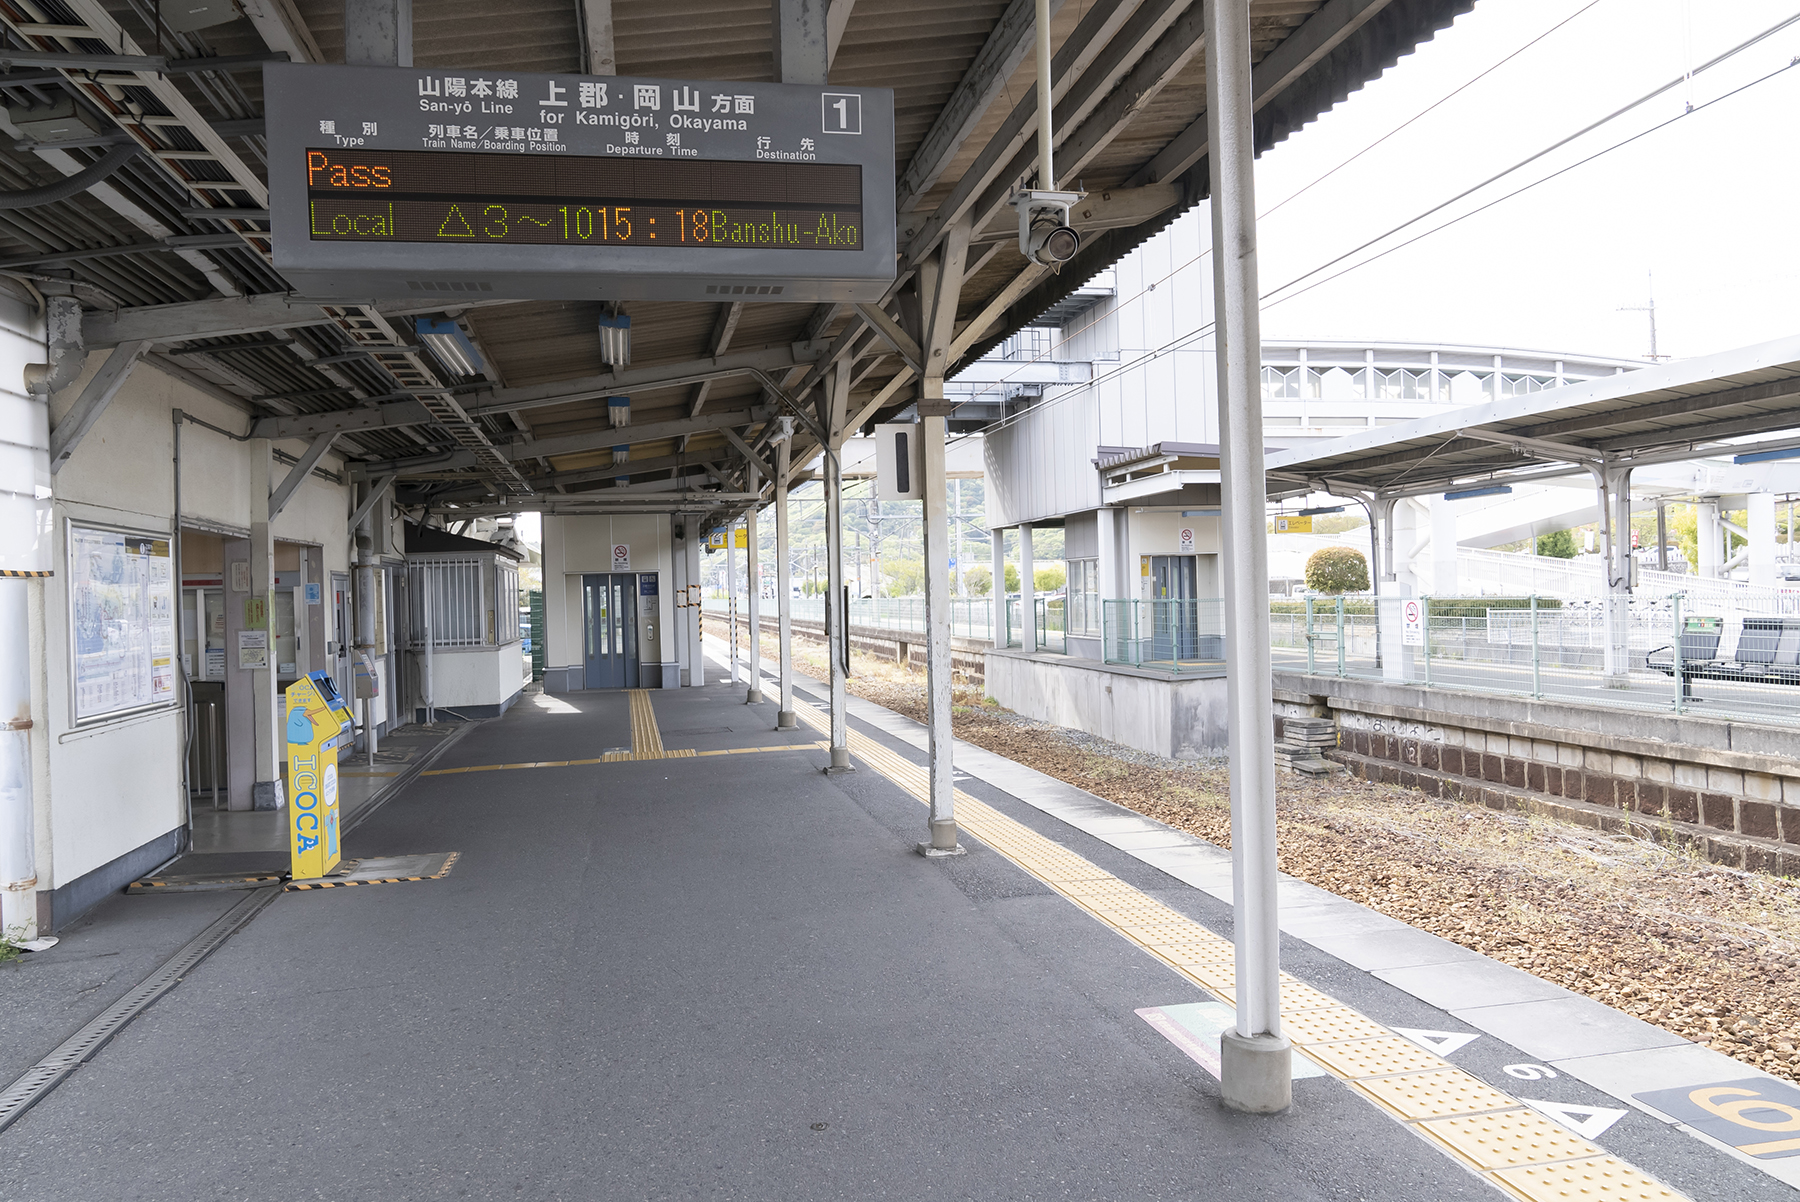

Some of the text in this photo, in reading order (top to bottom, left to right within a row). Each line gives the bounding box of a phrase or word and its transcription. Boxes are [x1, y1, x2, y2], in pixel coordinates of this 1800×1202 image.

[417, 76, 519, 99] 山陽本線
[711, 94, 755, 115] 方面
[419, 99, 513, 115] San-yō Line
[540, 110, 748, 133] for Kamigōri, Okayama
[832, 99, 847, 129] 1
[334, 134, 365, 148] Type
[422, 138, 567, 153] Train Name/Boarding Position
[606, 143, 698, 157] Departure Time
[756, 150, 816, 161] Destination
[307, 151, 392, 188] Pass
[310, 201, 394, 236] Local
[712, 210, 858, 245] Banshu-Ako
[293, 754, 319, 855] ICOCA
[1688, 1087, 1800, 1132] 6
